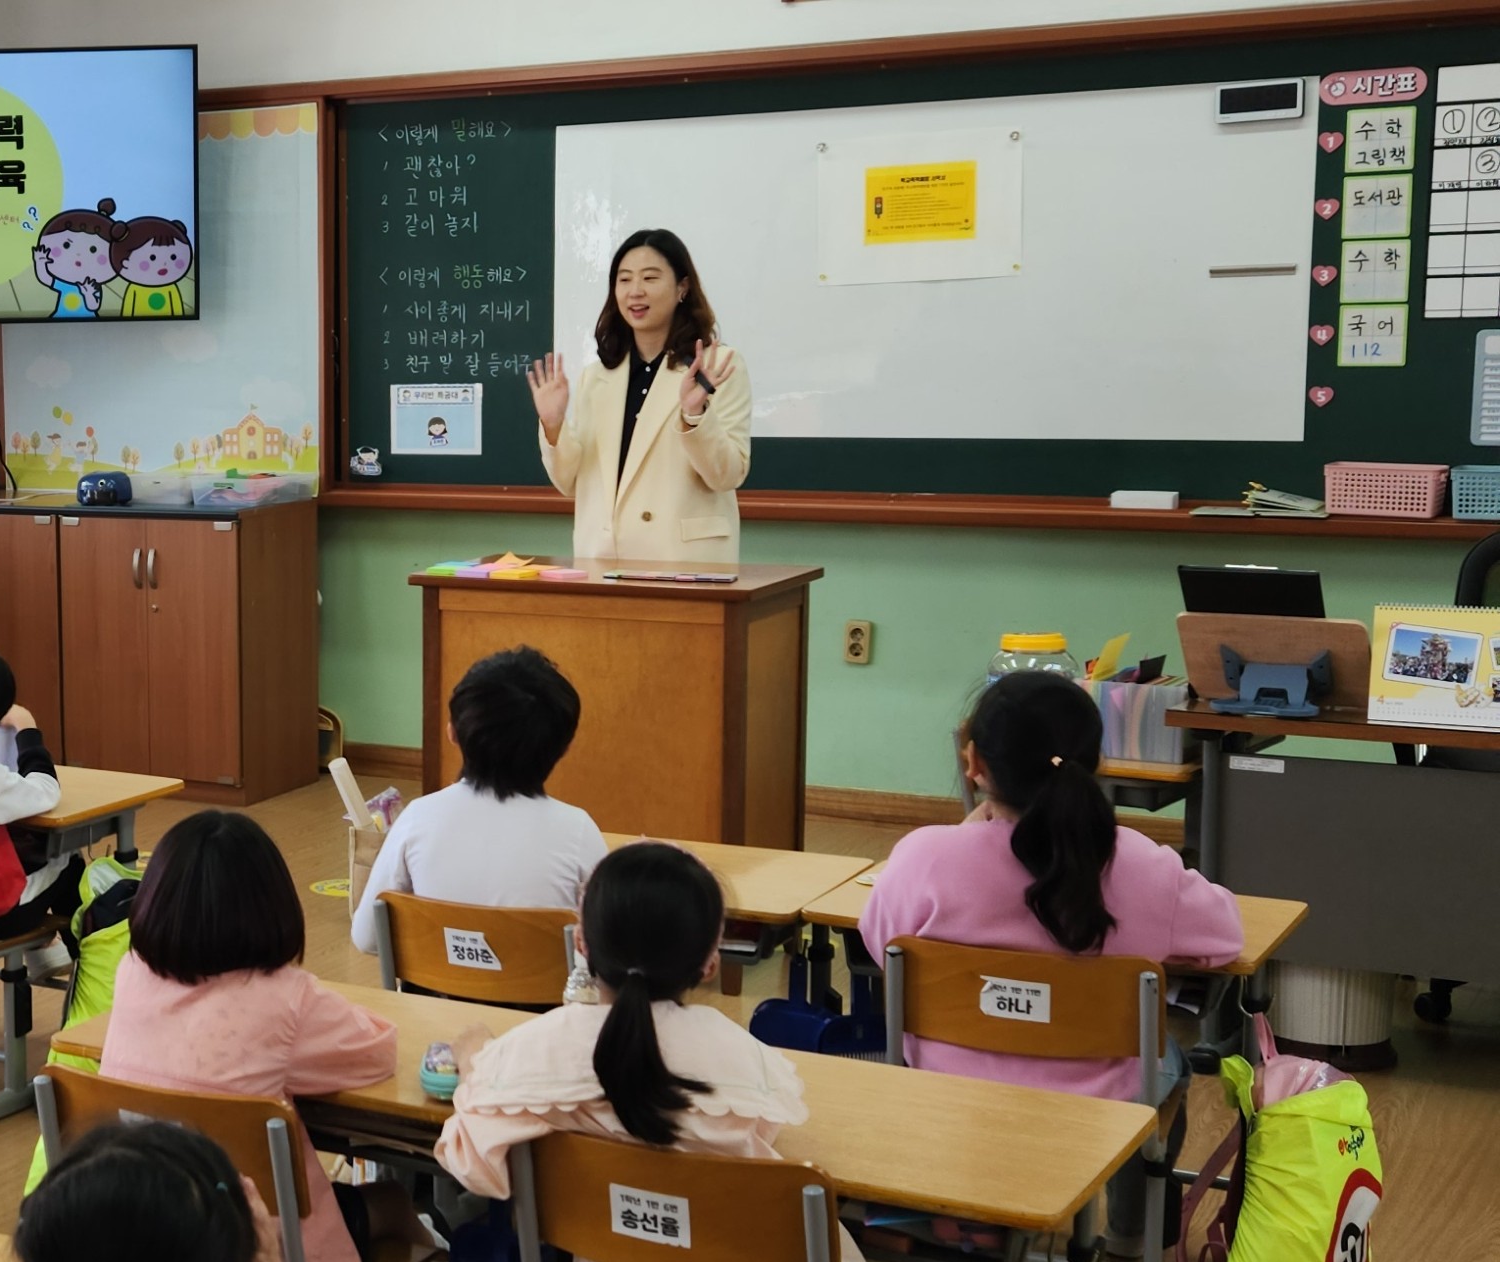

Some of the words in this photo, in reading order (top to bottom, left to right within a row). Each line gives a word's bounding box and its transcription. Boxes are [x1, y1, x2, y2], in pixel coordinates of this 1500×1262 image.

[1352, 73, 1417, 96] 시간표
[1327, 136, 1334, 148] 1
[1355, 145, 1406, 166] 그림책
[1353, 187, 1403, 206] 도서관
[1322, 204, 1331, 215] 2
[405, 213, 434, 236] 같이
[1319, 270, 1329, 281] 3
[404, 301, 466, 323] 사이좋게
[479, 300, 530, 322] 지내기
[408, 329, 485, 349] 배려하기
[1316, 329, 1328, 341] 4
[406, 355, 431, 373] 친구
[465, 352, 480, 376] 잘
[1316, 391, 1326, 402] 5
[452, 944, 493, 964] 정하준
[996, 996, 1033, 1014] 하나
